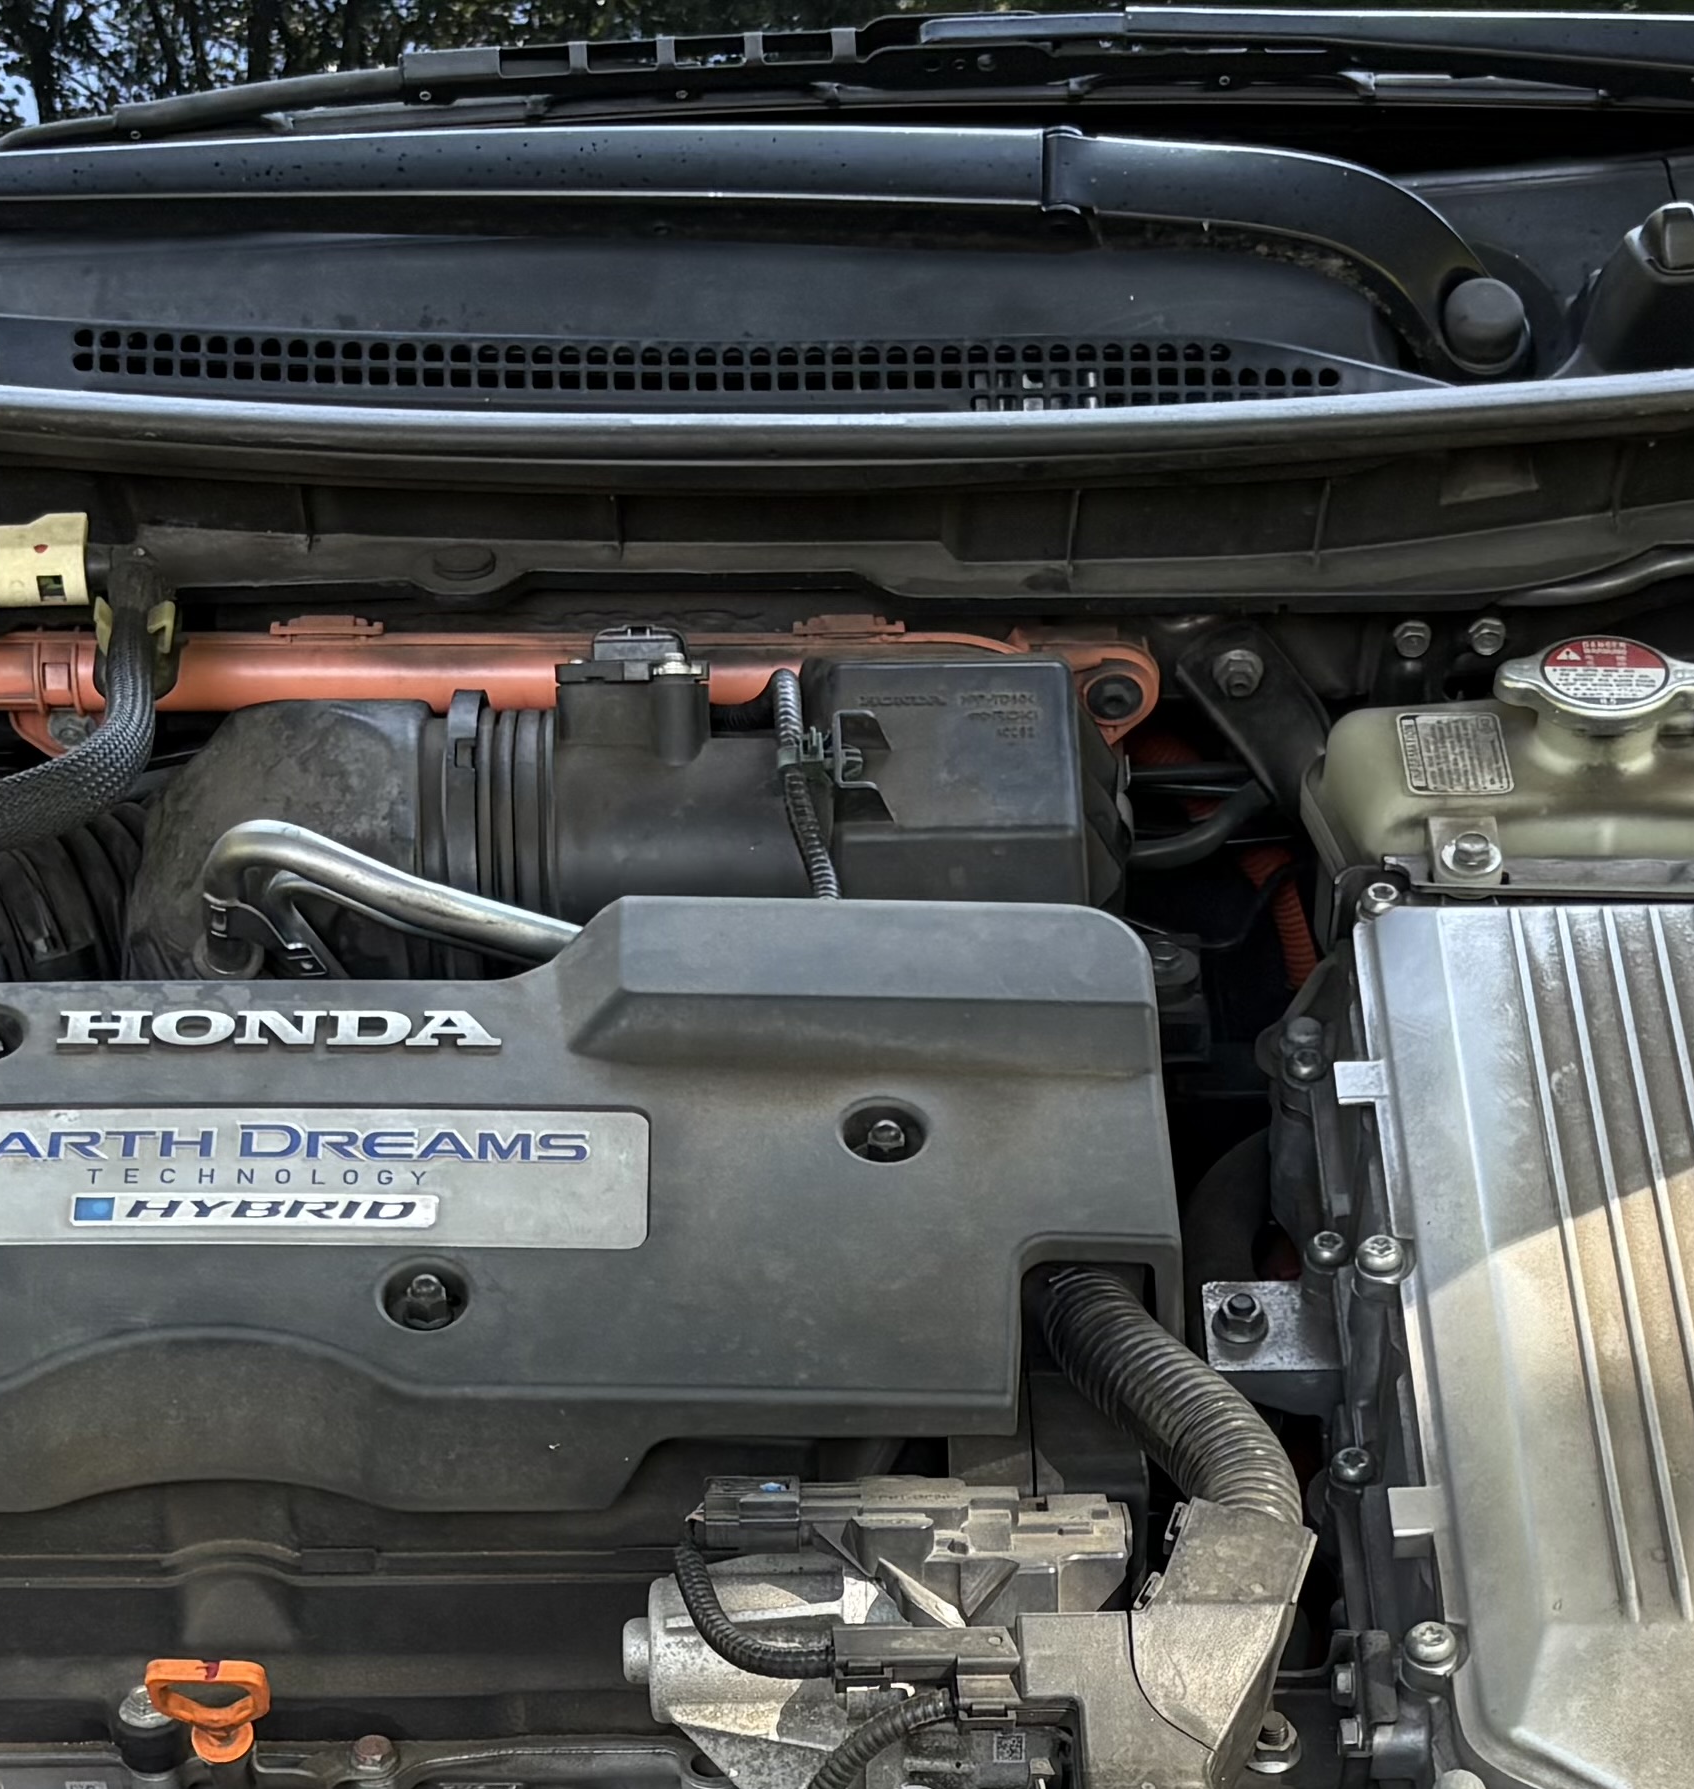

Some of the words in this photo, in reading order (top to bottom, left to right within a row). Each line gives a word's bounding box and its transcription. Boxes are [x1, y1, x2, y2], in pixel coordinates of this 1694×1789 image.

[56, 1010, 502, 1050] HONDA
[237, 1122, 591, 1163] DREAMS
[88, 1168, 429, 1186] TECHNOLOGY
[125, 1198, 418, 1222] HYBRID
